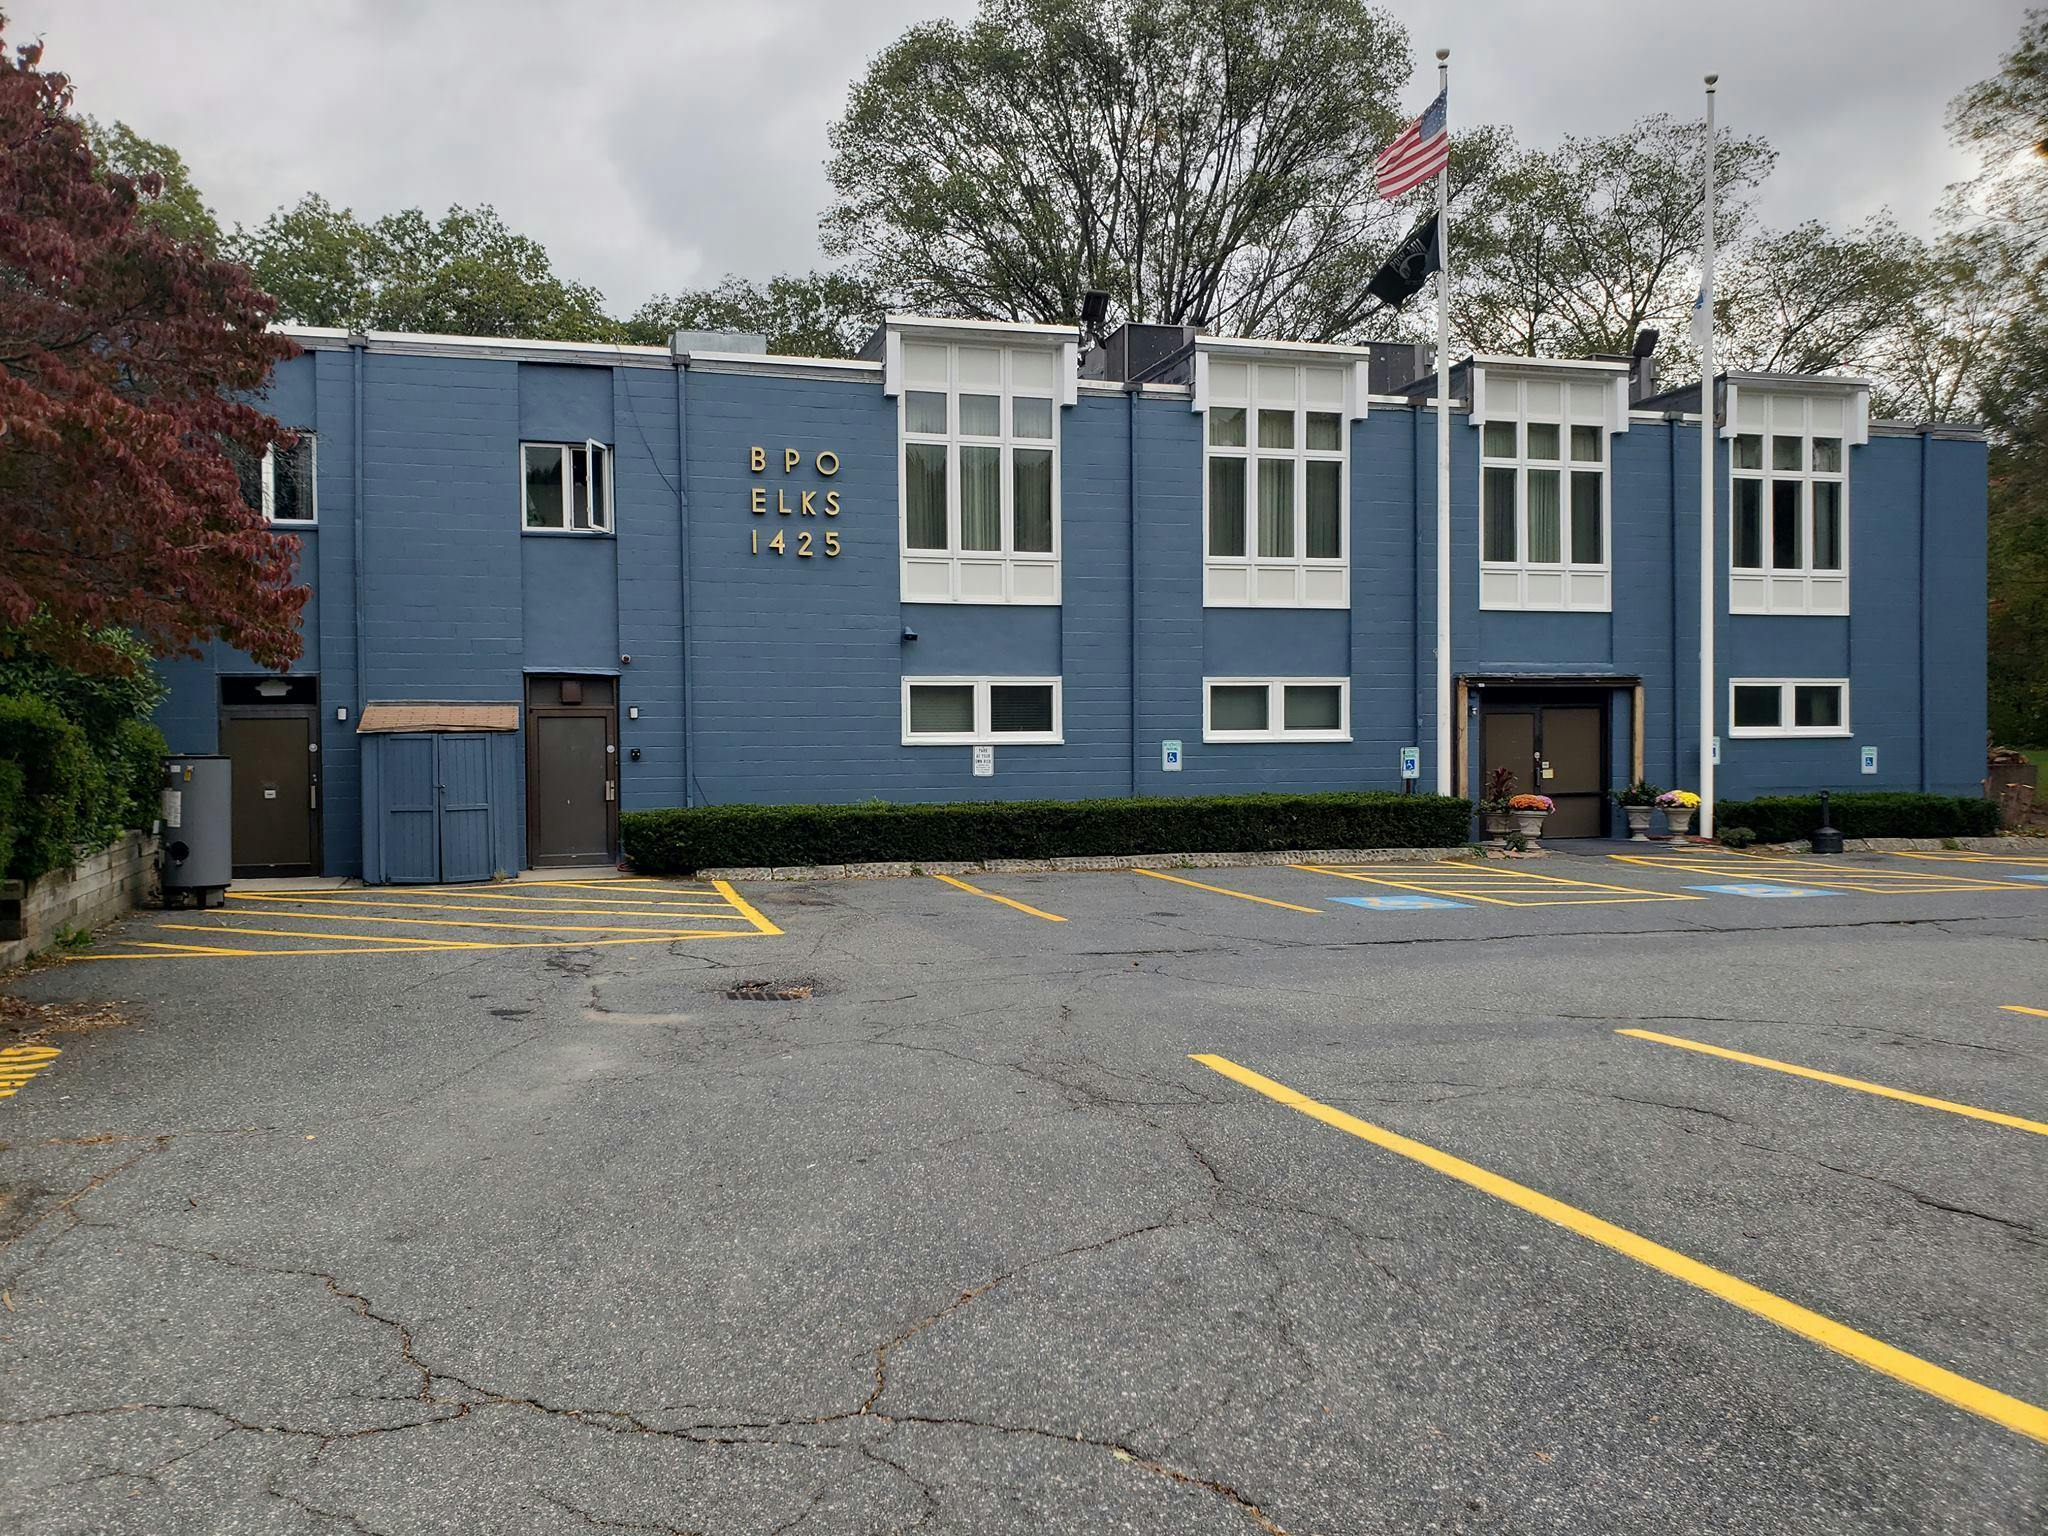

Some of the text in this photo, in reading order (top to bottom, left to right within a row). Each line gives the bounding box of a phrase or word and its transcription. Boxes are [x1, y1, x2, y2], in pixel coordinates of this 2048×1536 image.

[1389, 250, 1406, 273] POW
[751, 488, 841, 516] ELKS
[751, 529, 841, 557] 1425
